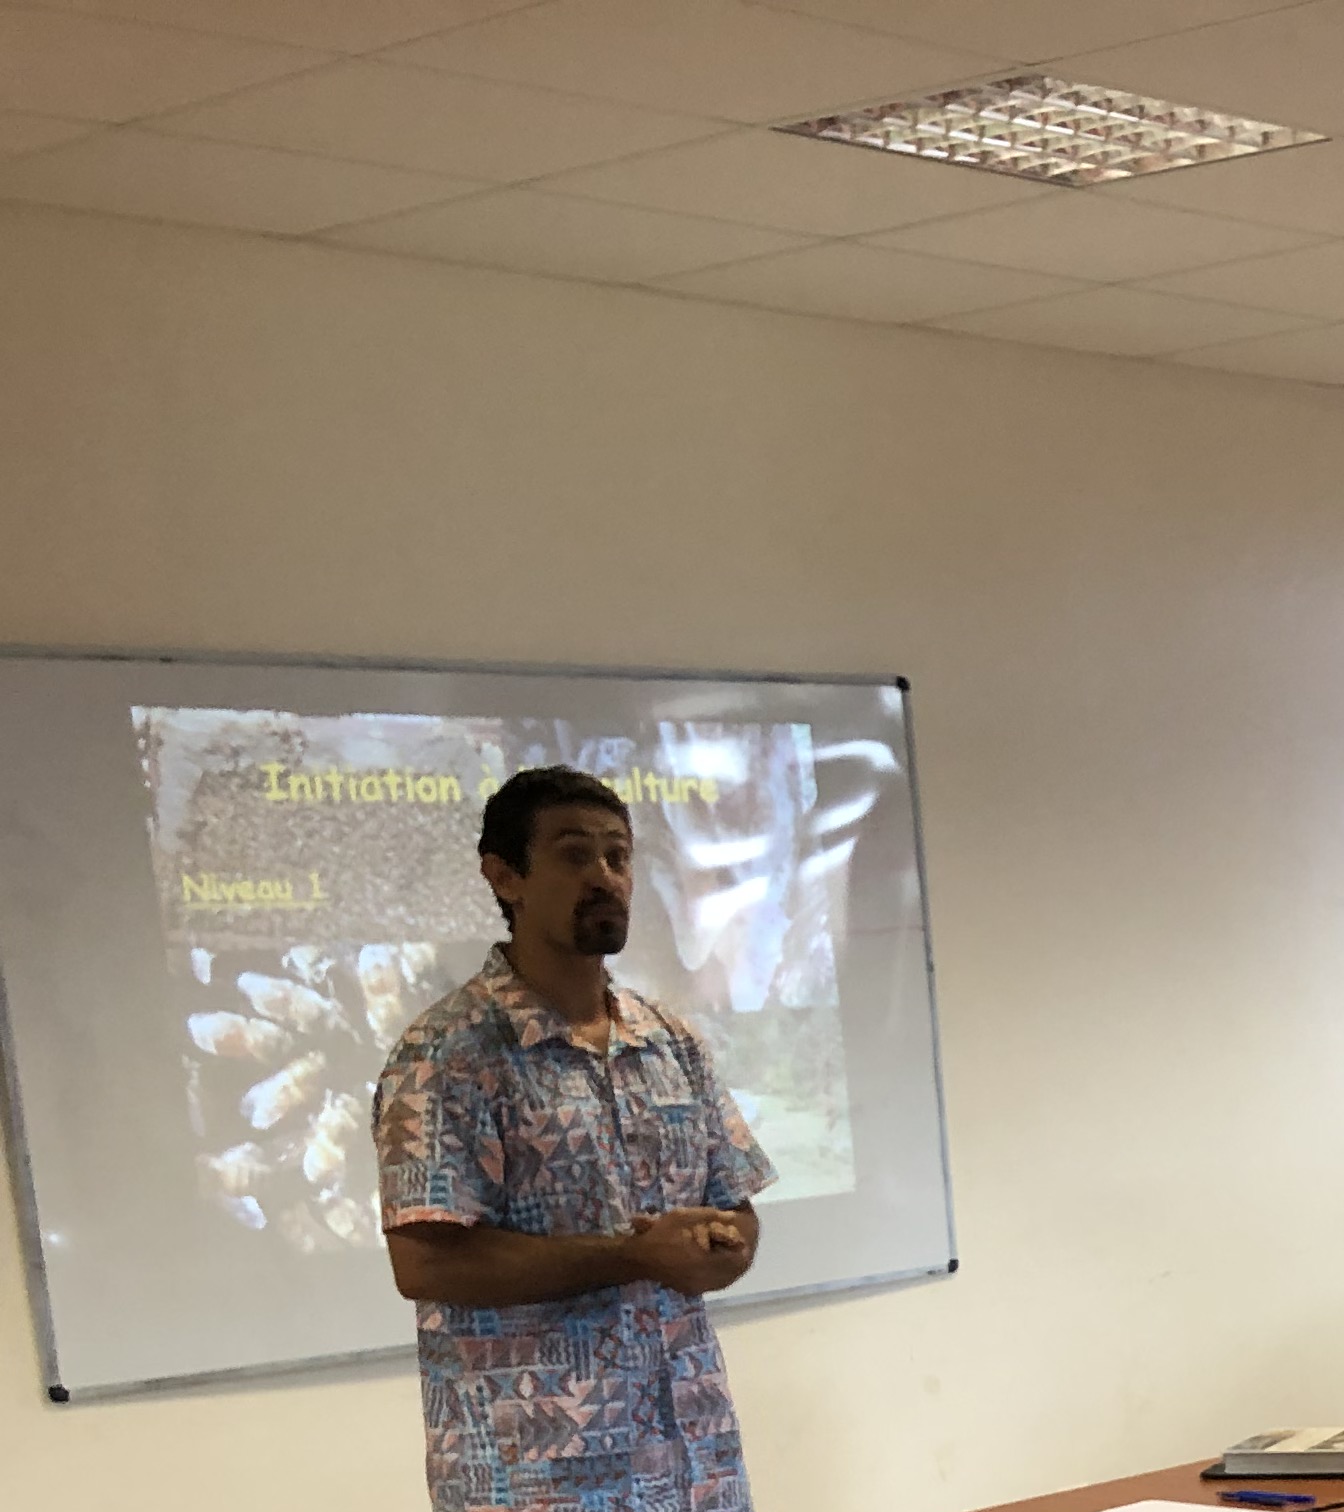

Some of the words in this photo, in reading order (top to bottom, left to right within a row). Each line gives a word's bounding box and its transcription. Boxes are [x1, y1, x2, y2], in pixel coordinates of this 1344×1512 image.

[260, 762, 462, 802] Initiation
[180, 870, 293, 901] Niveau
[308, 868, 330, 900] 1
